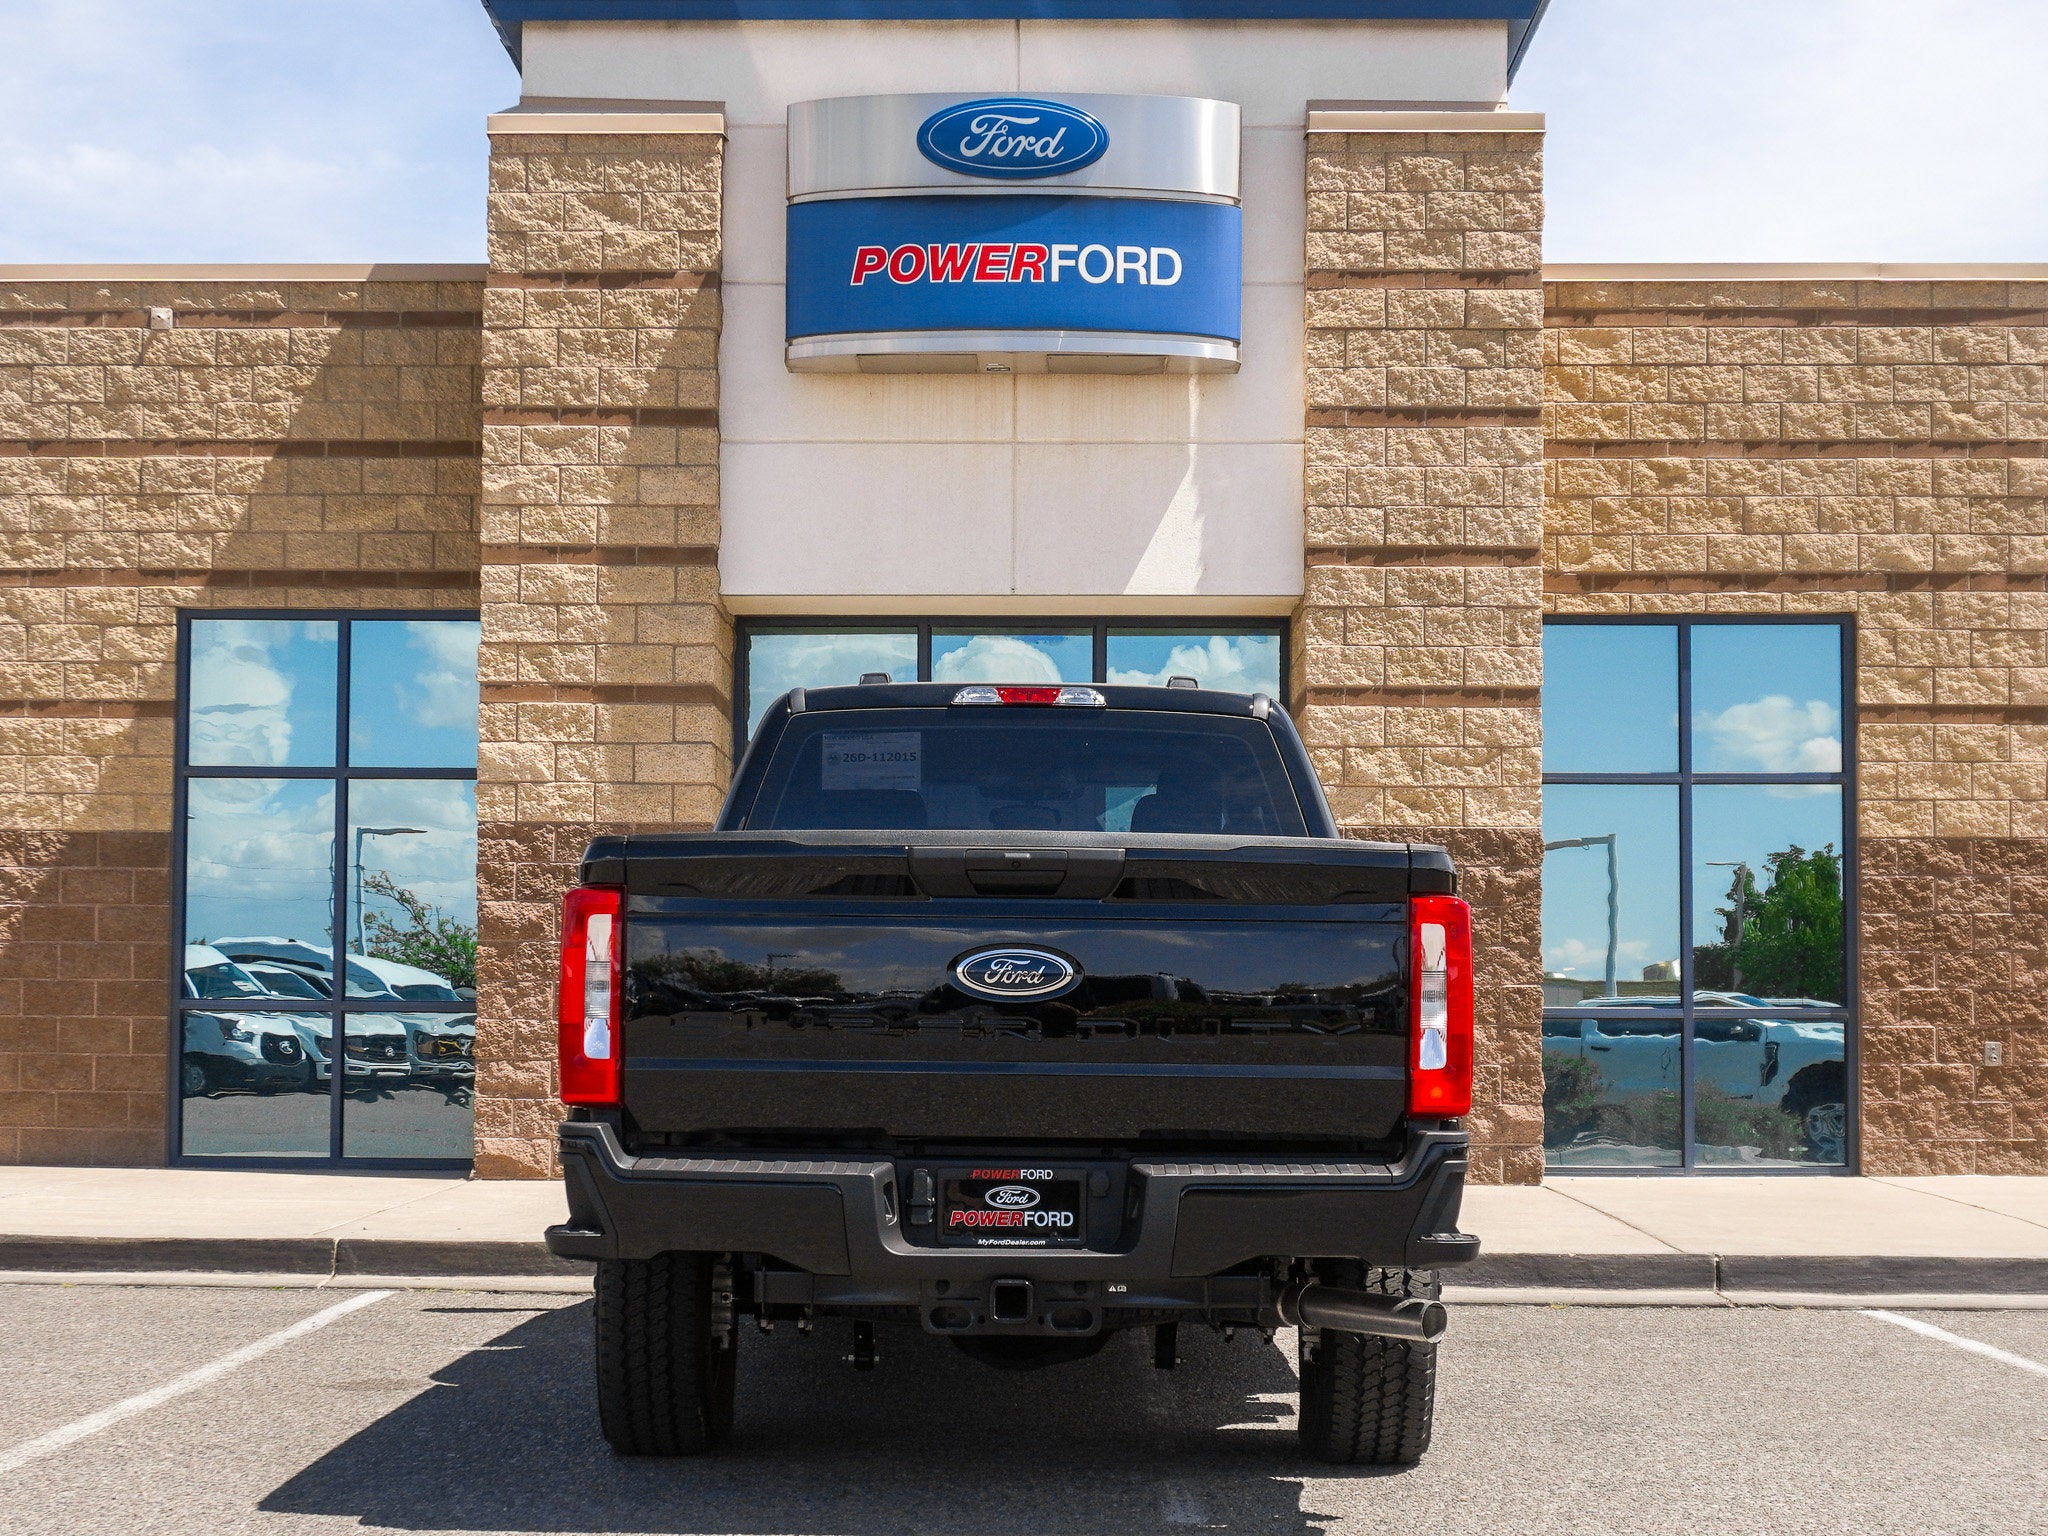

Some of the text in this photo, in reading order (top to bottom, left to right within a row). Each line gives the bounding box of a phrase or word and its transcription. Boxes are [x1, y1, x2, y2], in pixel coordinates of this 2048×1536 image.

[960, 114, 1066, 160] Ford
[850, 243, 1183, 286] POWERFORD
[842, 751, 917, 763] 26D-112015
[984, 958, 1046, 984] Ford
[972, 1169, 1054, 1180] POWERFORD
[996, 1188, 1030, 1205] Ford
[950, 1211, 1074, 1227] POWERFORD
[977, 1238, 1046, 1247] MyFordDealer.com
